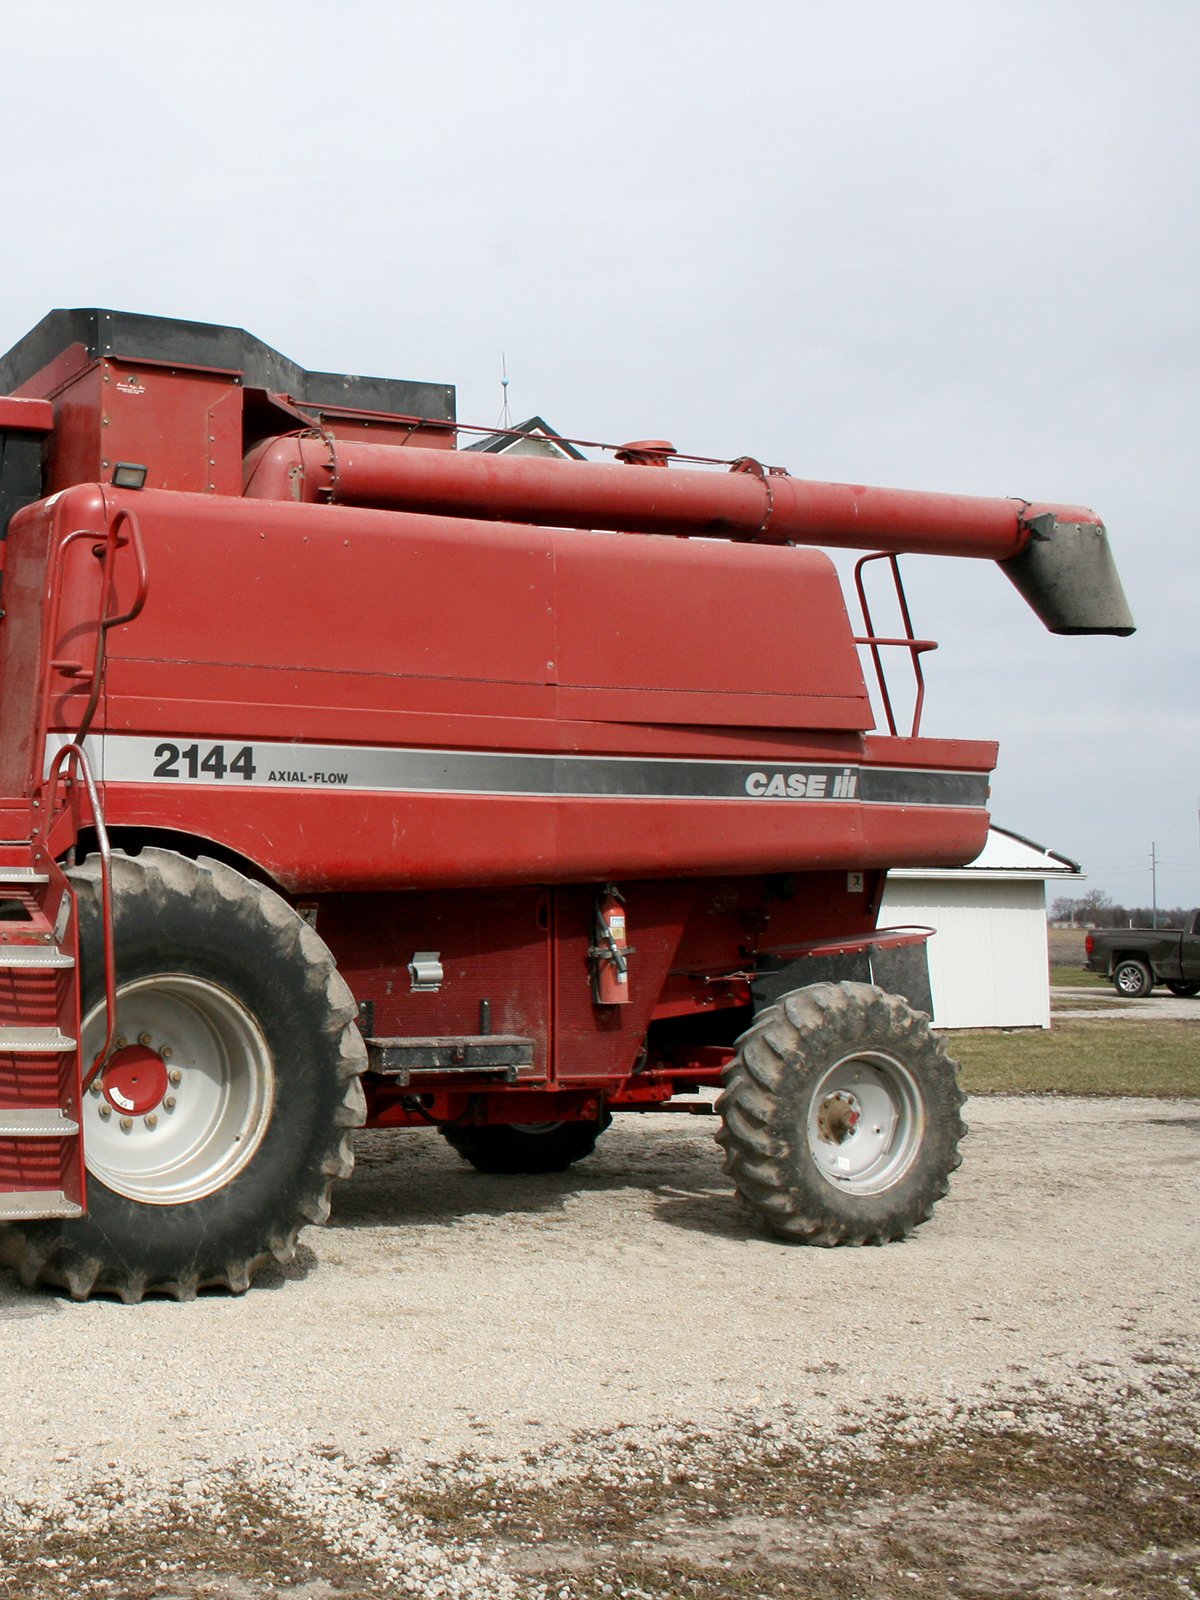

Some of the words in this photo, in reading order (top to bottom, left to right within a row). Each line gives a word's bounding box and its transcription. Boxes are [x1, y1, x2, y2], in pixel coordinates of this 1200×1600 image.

[153, 743, 256, 780] 2144
[268, 771, 349, 784] AXIAL-FLOW
[745, 772, 827, 797] CASE
